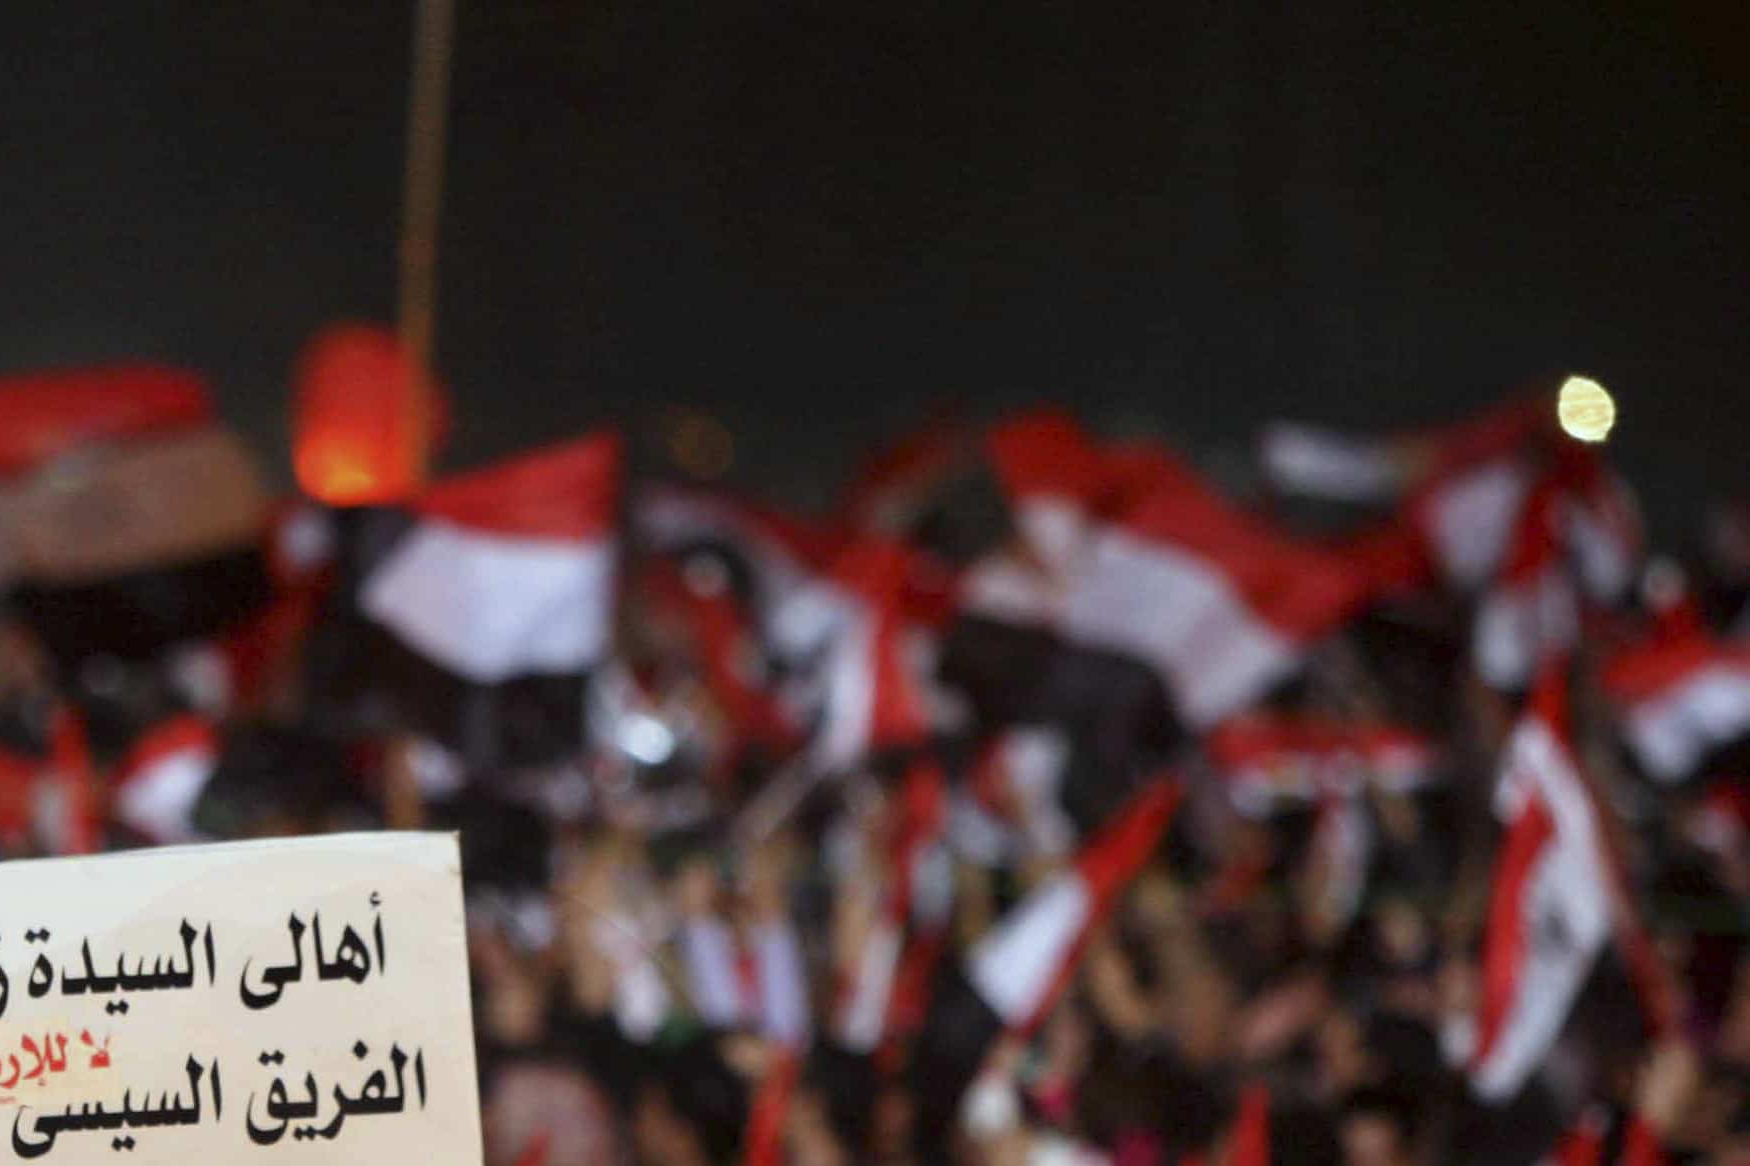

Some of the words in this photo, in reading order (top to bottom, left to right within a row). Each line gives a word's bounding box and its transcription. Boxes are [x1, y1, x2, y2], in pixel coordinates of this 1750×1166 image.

[25, 918, 216, 1015] السيدة
[239, 892, 386, 1010] أهالى
[79, 1029, 111, 1069] لا
[246, 1039, 427, 1146] الفريق
